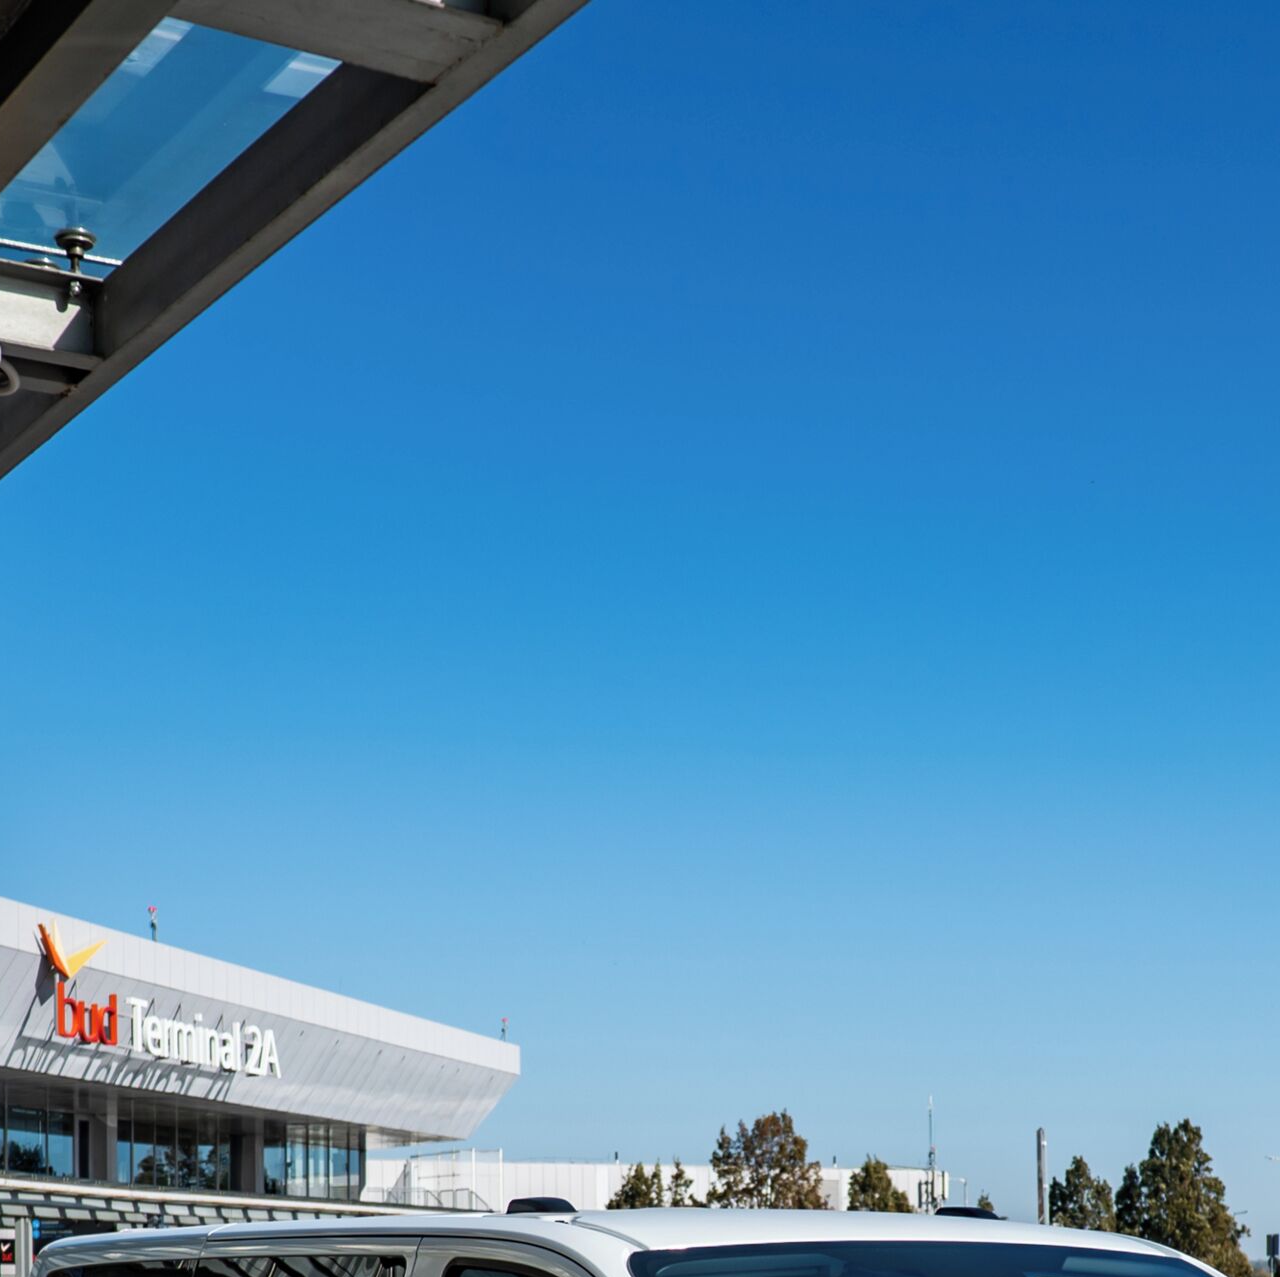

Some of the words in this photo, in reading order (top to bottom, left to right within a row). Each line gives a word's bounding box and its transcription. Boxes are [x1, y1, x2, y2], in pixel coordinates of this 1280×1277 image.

[56, 980, 118, 1046] bud
[126, 996, 242, 1072] Terminal
[243, 1024, 282, 1079] 2A
